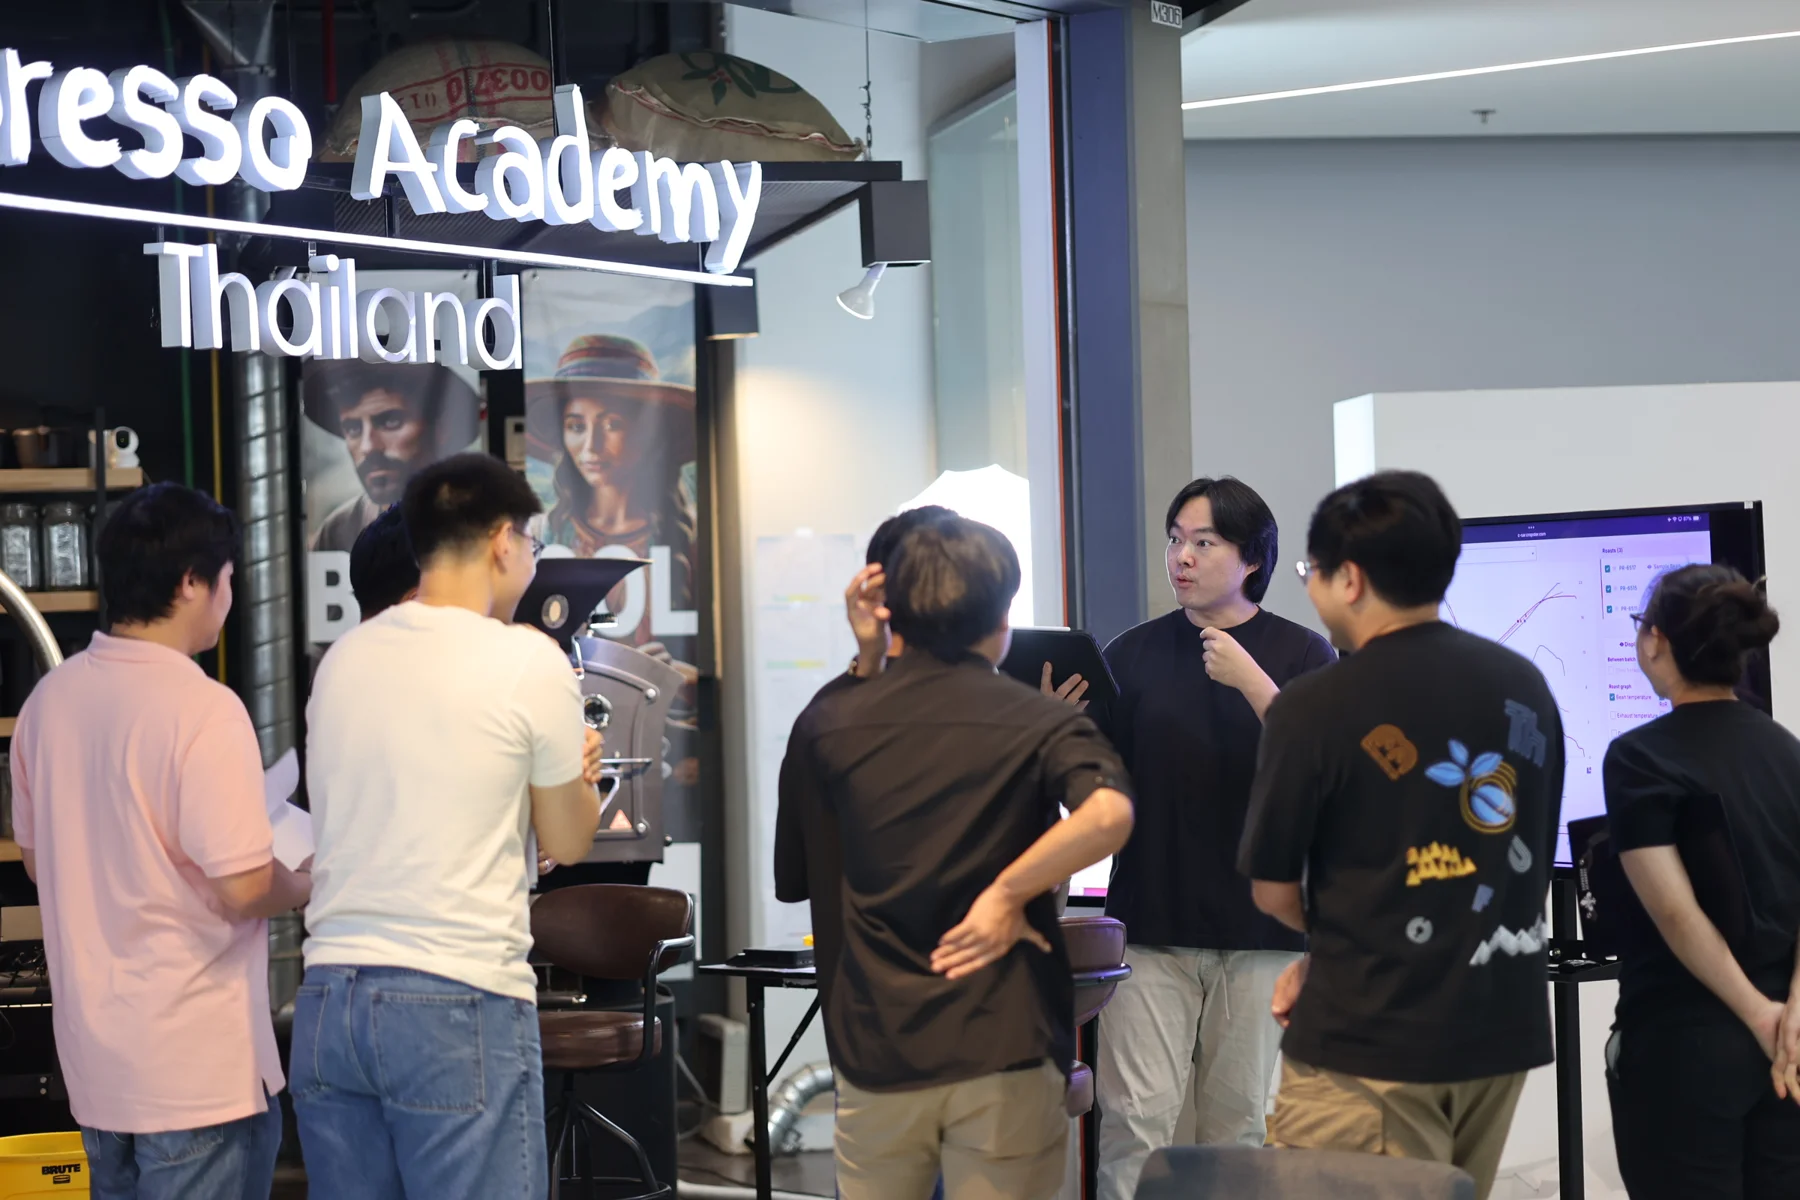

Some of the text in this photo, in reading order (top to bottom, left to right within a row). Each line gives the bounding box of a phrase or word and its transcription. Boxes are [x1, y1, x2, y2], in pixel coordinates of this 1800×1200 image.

[0, 47, 763, 275] resso Academy
[144, 240, 522, 371] Thailand
[41, 1163, 81, 1175] BRUTE
